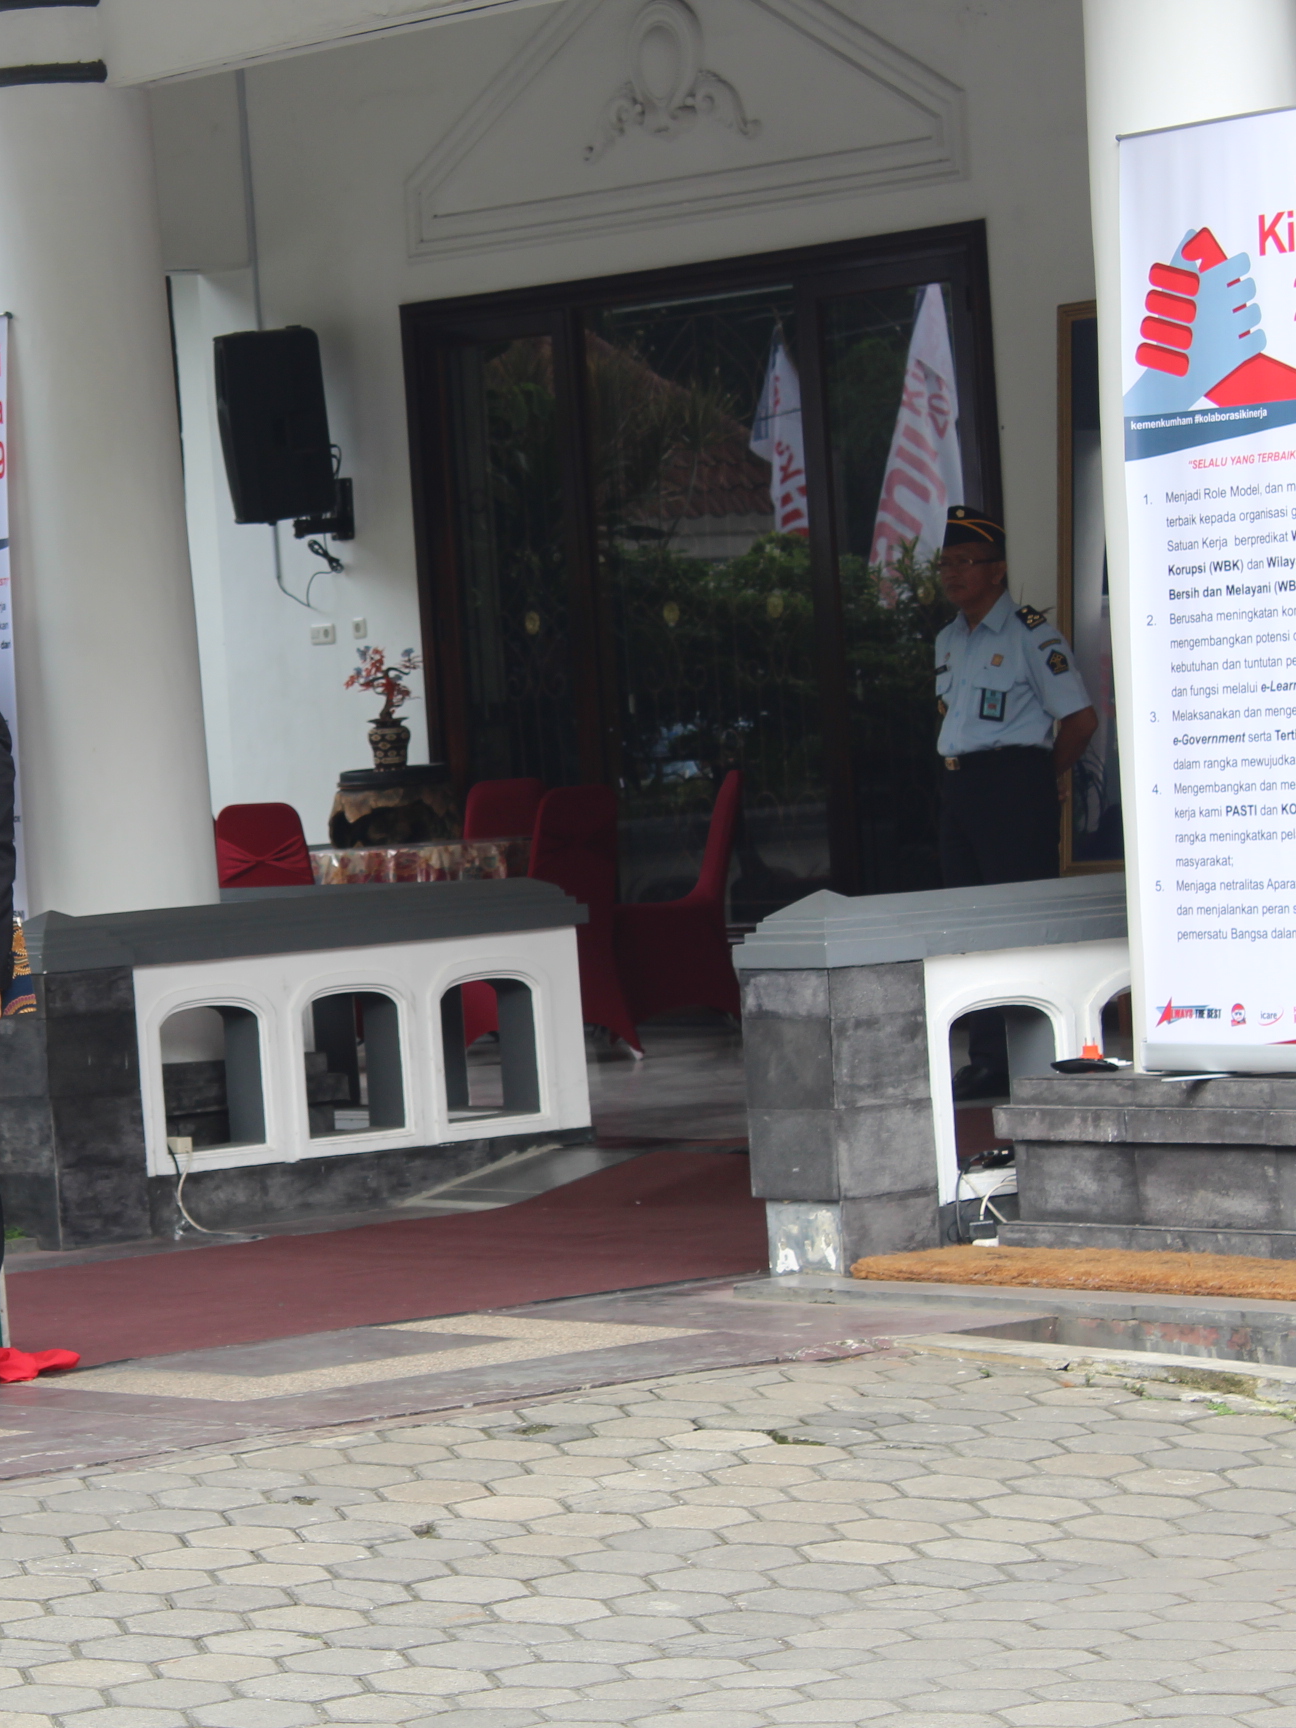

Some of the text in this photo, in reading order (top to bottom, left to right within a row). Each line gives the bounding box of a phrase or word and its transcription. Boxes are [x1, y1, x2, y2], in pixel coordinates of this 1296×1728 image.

[1130, 407, 1268, 431] kemenkumham #kolaborasikinerja
[1230, 454, 1255, 466] YANG
[1143, 494, 1153, 505] 1.
[1165, 489, 1202, 505] Menjadi
[1204, 487, 1227, 500] Role
[1230, 483, 1263, 497] Model,
[1265, 482, 1284, 495] dan
[1166, 513, 1197, 528] terbaik
[1199, 511, 1236, 526] kepada
[1239, 506, 1288, 524] organisasi
[1167, 538, 1199, 552] Satuan
[1202, 536, 1228, 550] Kerja
[1234, 530, 1289, 548] berpredikat
[1168, 561, 1207, 577] Korupsi
[1209, 559, 1244, 575] (WBK)
[1247, 557, 1265, 570] dan
[1169, 587, 1200, 601] Bersih
[1202, 585, 1222, 598] dan
[1225, 581, 1272, 597] Melayani
[1146, 614, 1157, 626] 2.
[1169, 609, 1213, 625] Berusaha
[1216, 606, 1279, 623] meningkatan
[1170, 632, 1253, 650] mengembangkan
[1256, 629, 1290, 645] potensi
[1170, 660, 1219, 674] kebutuhan
[1222, 659, 1241, 671] dan
[1244, 656, 1283, 670] tuntutan
[1171, 686, 1188, 698] dan
[1190, 683, 1219, 699] fungsi
[1223, 682, 1258, 694] melalui
[1149, 711, 1160, 723] 3.
[1172, 708, 1241, 722] Melaksanakan
[1244, 706, 1262, 718] dan
[1173, 732, 1246, 746] e-Government
[1248, 731, 1272, 743] serta
[1173, 758, 1201, 770] dalam
[1203, 756, 1238, 771] rangka
[1152, 784, 1162, 795] 4.
[1174, 781, 1257, 797] Mengembangkan
[1260, 780, 1278, 791] dan
[1174, 807, 1196, 821] kerja
[1198, 806, 1223, 818] kami
[1225, 804, 1257, 817] PASTI
[1260, 804, 1278, 816] dan
[1175, 831, 1207, 846] rangka
[1209, 829, 1278, 844] meningkatkan
[1176, 855, 1233, 869] masyarakat;
[1155, 880, 1165, 892] 5.
[1176, 879, 1217, 894] Menjaga
[1220, 878, 1264, 891] netralitas
[1176, 904, 1194, 916] dan
[1196, 903, 1259, 918] menjalankan
[1262, 904, 1290, 917] peran
[1177, 928, 1228, 942] pemersatu
[1231, 927, 1268, 942] Bangsa
[1207, 1008, 1222, 1019] BEST
[1260, 1010, 1278, 1020] icare
